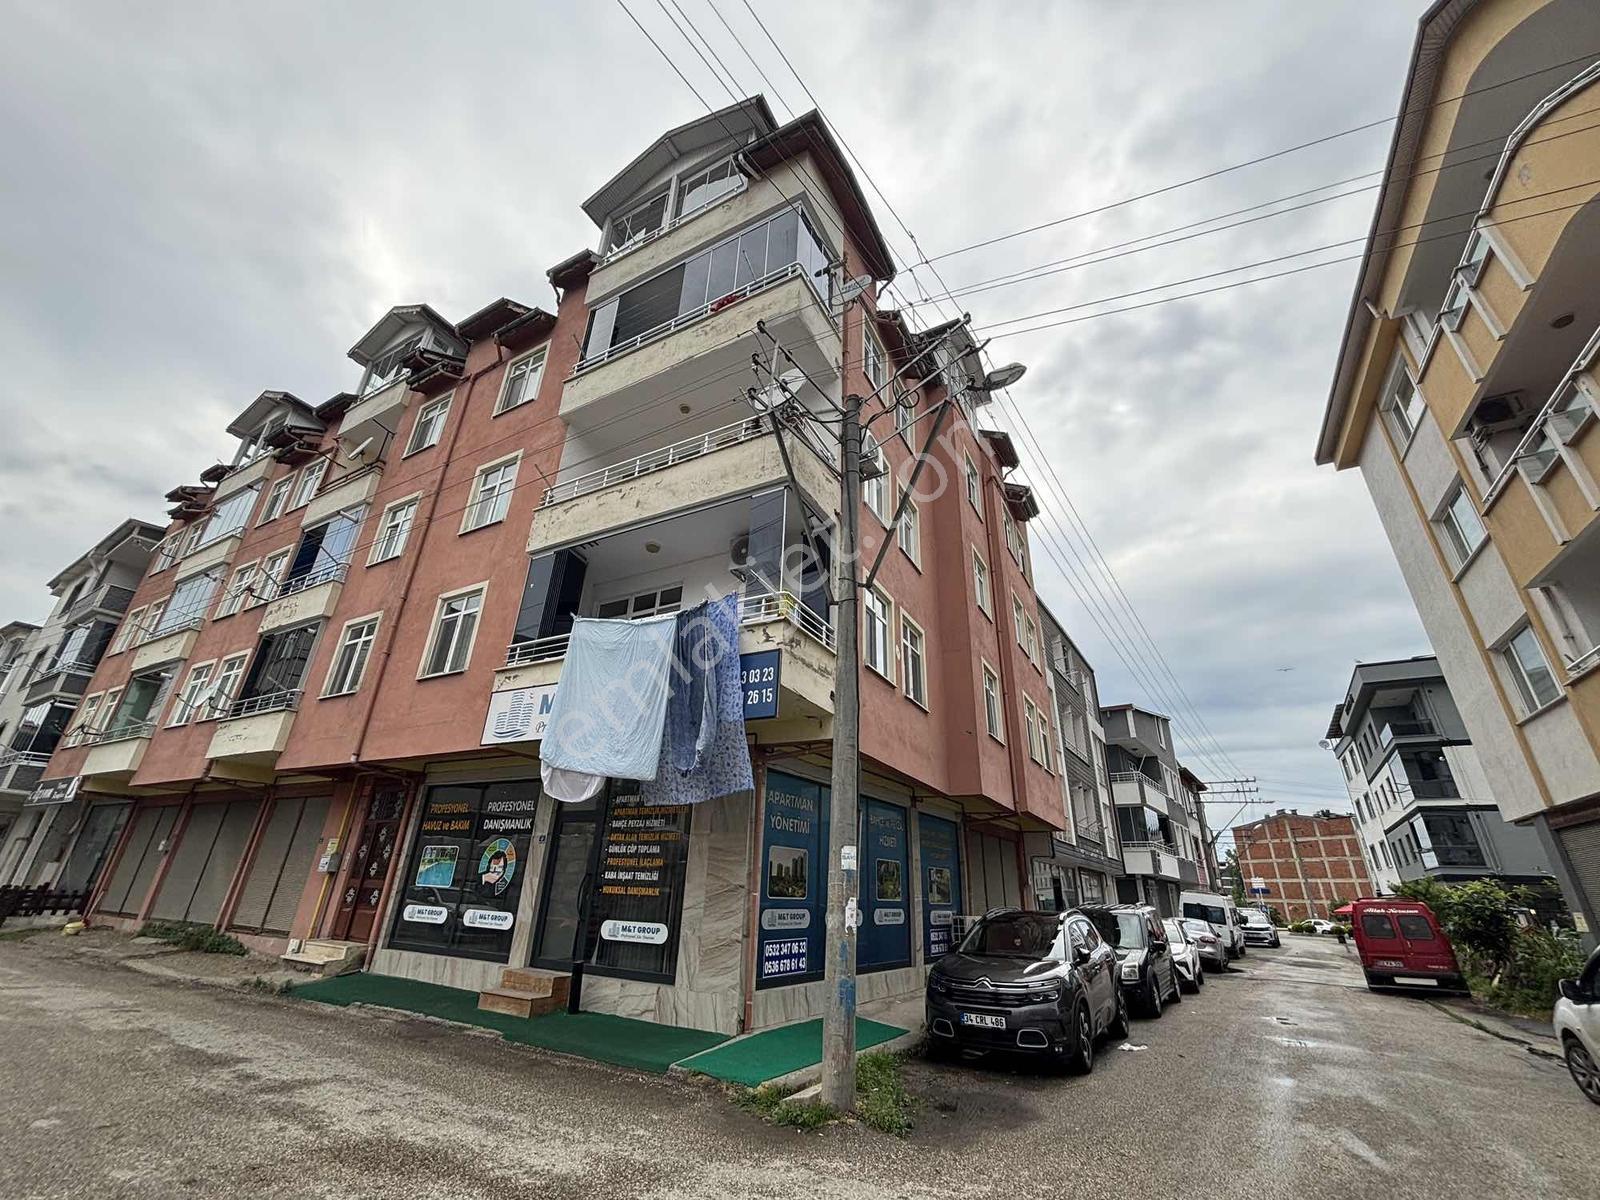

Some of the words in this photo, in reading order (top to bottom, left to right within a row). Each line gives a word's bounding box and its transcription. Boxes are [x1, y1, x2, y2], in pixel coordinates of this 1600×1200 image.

[749, 669, 761, 684] 03
[762, 667, 774, 682] 23
[747, 690, 759, 705] 26
[761, 688, 773, 703] 15
[768, 790, 814, 811] APARTMAN
[483, 818, 533, 832] DANIŞMANLIK
[604, 871, 617, 880] KABA
[427, 909, 443, 917] GROUP
[490, 914, 508, 922] GROUP
[621, 925, 637, 934] M&T
[637, 926, 661, 935] GROUP
[765, 944, 780, 957] 0532
[780, 942, 791, 955] 347
[799, 941, 807, 954] 33
[764, 960, 779, 974] 0536
[780, 958, 790, 972] 678
[791, 958, 798, 971] 61
[799, 957, 806, 969] 43
[964, 1014, 974, 1024] 34
[975, 1015, 989, 1026] CRL
